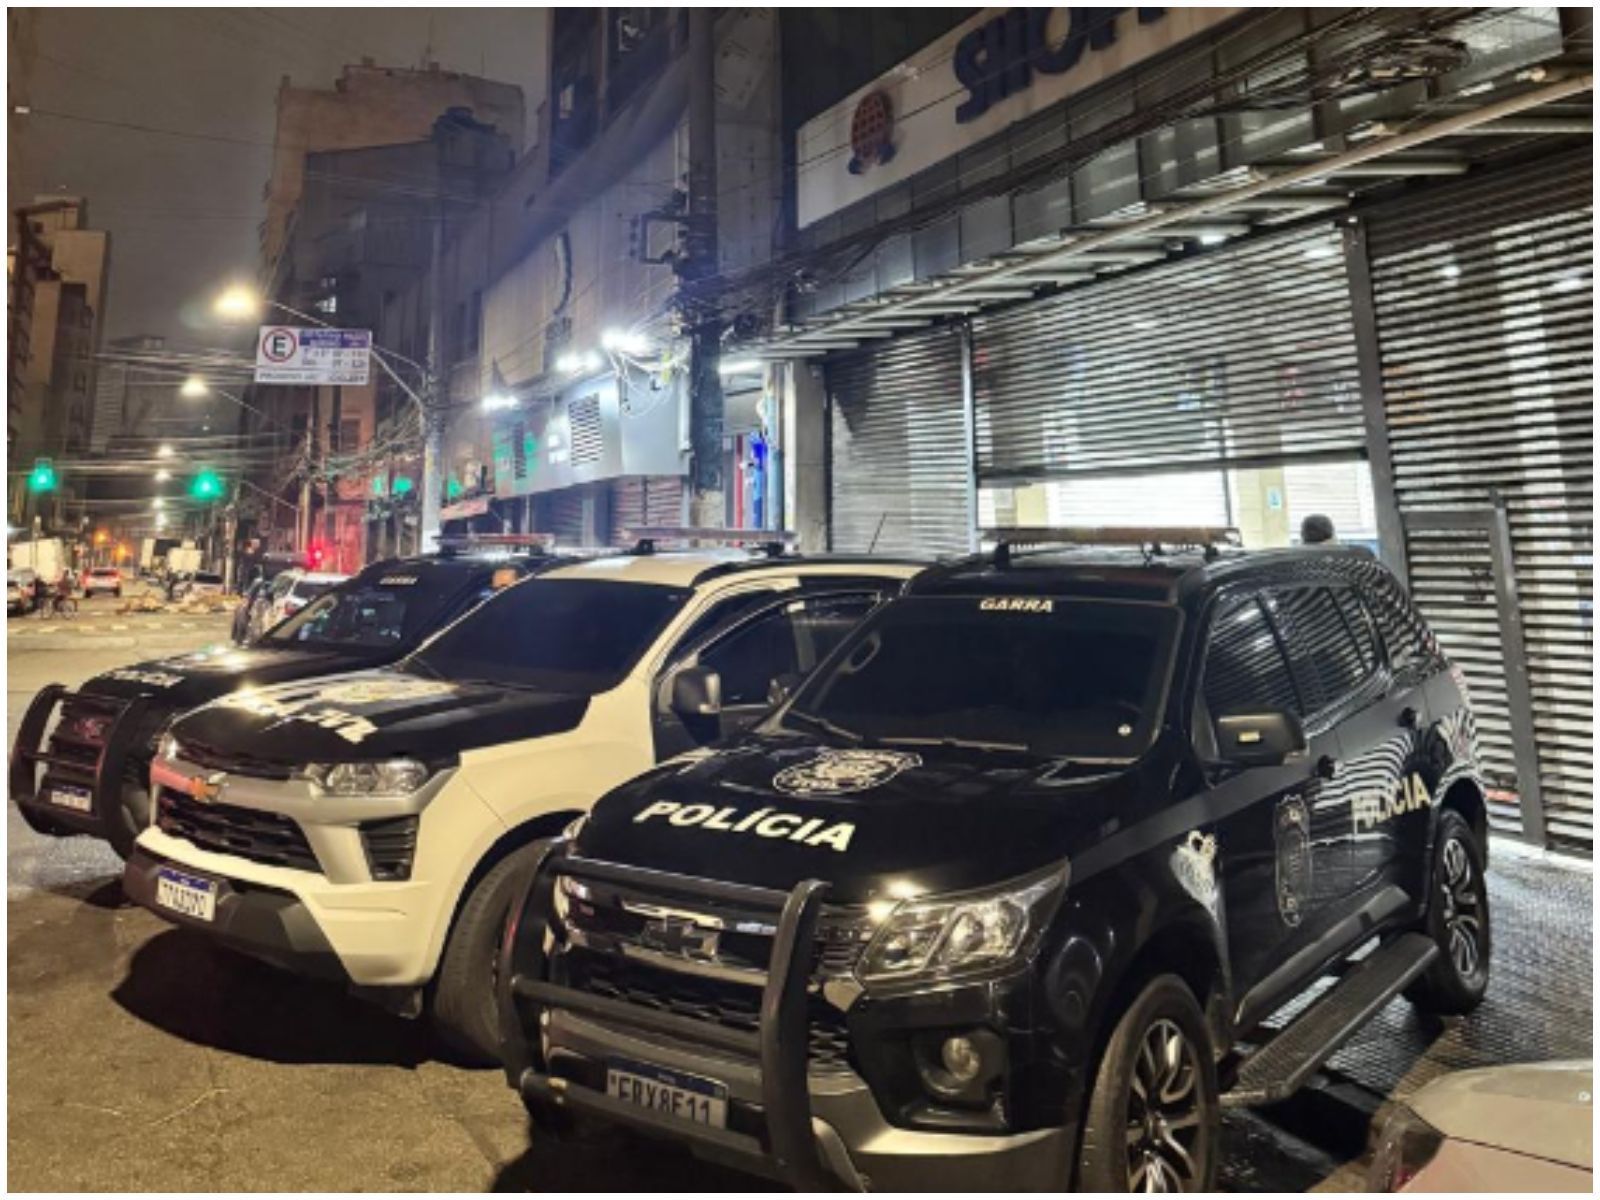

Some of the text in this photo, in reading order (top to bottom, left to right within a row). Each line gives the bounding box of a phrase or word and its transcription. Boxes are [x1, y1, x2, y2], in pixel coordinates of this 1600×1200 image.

[272, 335, 287, 358] E
[979, 597, 1053, 614] GARRA
[632, 800, 857, 853] POLÍCIA
